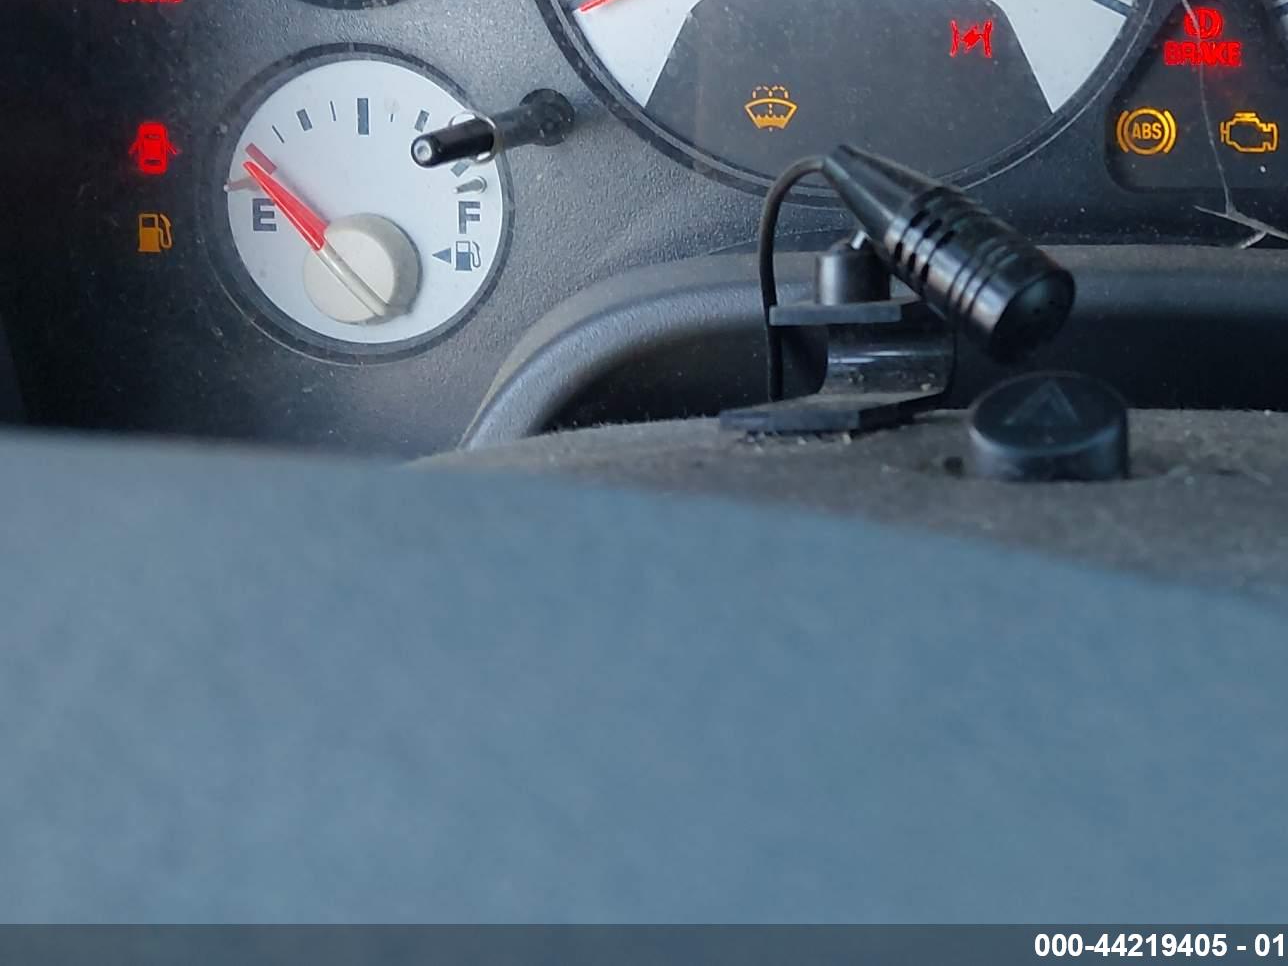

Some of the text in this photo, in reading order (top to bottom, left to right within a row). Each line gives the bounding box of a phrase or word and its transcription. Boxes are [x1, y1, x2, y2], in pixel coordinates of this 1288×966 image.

[1163, 41, 1242, 67] BRAKE
[1132, 122, 1162, 140] ABS
[252, 198, 277, 232] E
[458, 201, 481, 233] F
